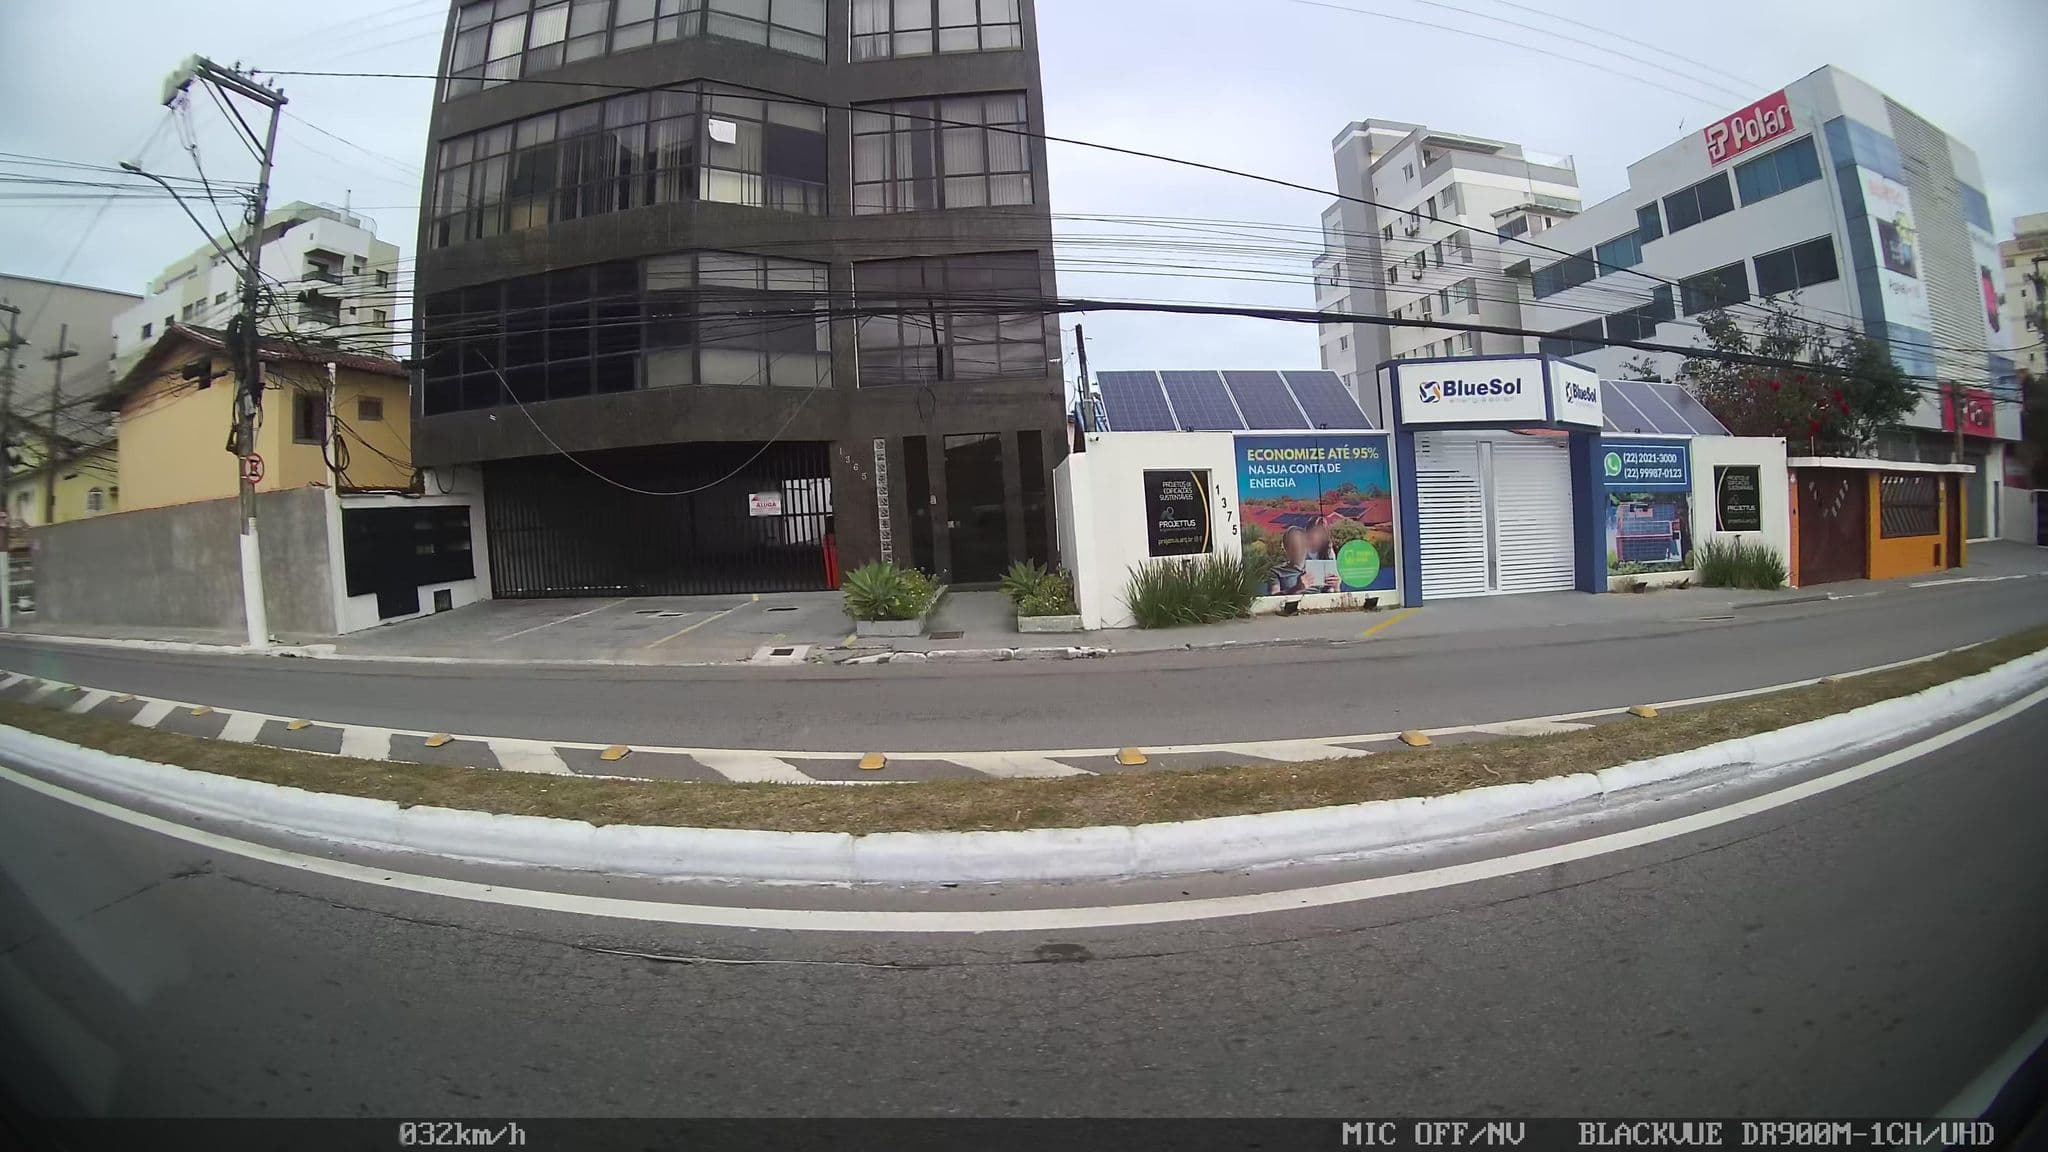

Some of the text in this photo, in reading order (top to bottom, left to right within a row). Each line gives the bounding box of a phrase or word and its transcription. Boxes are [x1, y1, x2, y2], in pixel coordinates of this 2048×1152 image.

[1730, 104, 1788, 150] Polar
[1442, 378, 1522, 396] BlueSol
[1572, 383, 1597, 403] BlueSol
[1247, 444, 1380, 461] ECONOMIZE ATÉ 95%
[1623, 452, 1678, 465] (22) 2021-3000
[1248, 463, 1342, 475] NA SUA CONTA DE
[1624, 467, 1639, 480] (22)
[1249, 477, 1297, 488] ENERGIA
[1215, 484, 1238, 536] 1375
[1158, 519, 1197, 528] PROJETTUS
